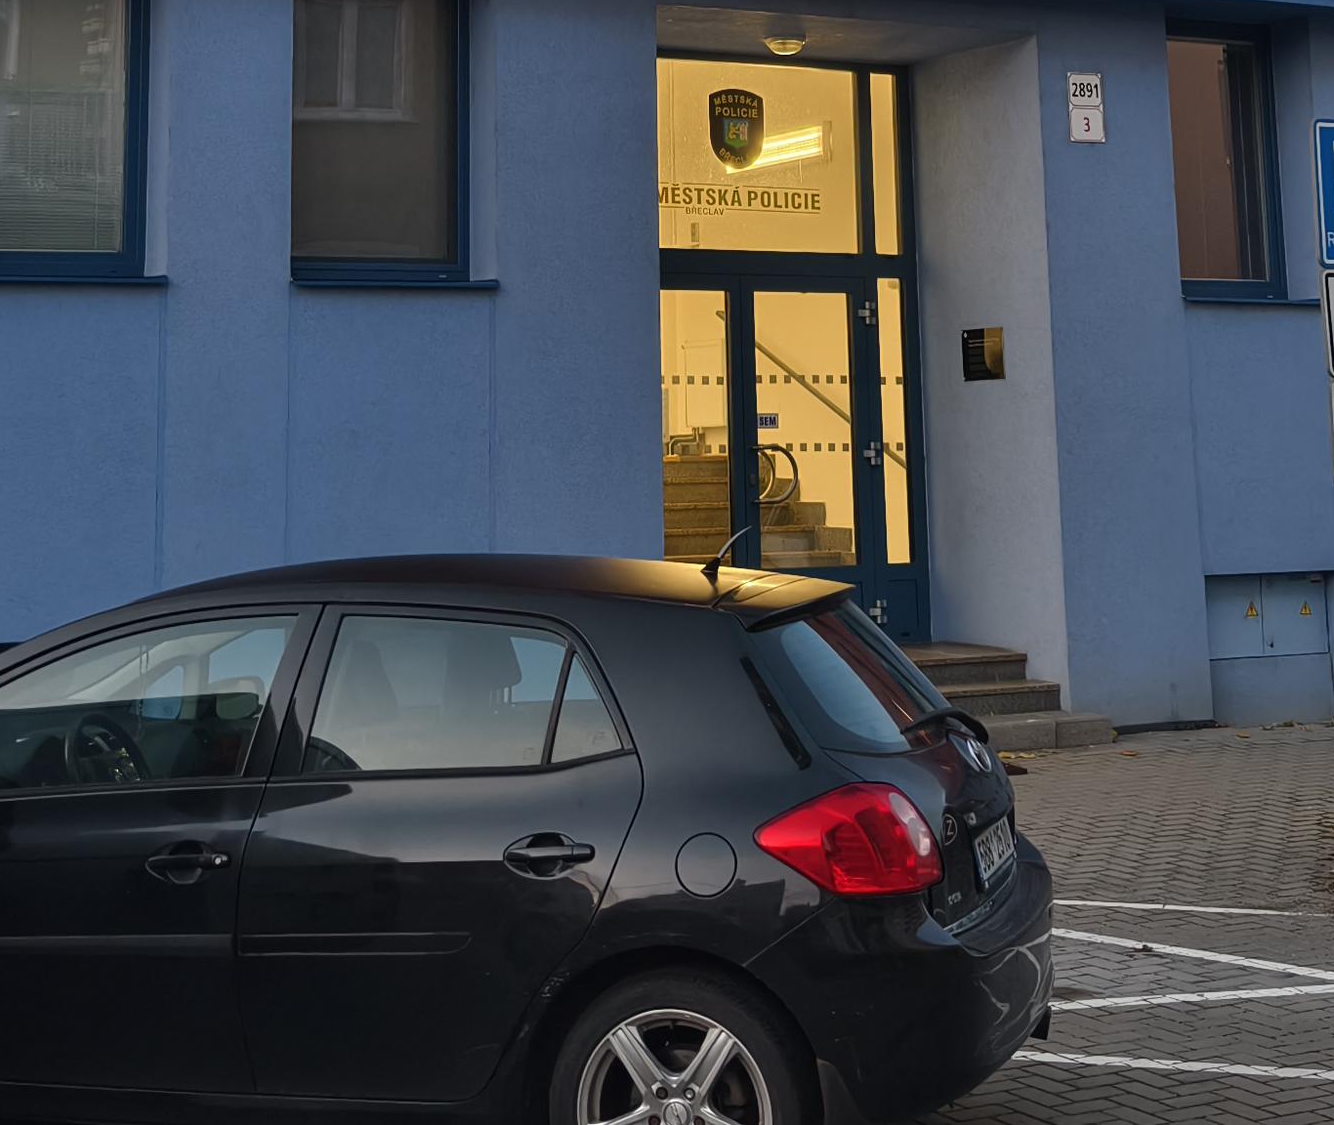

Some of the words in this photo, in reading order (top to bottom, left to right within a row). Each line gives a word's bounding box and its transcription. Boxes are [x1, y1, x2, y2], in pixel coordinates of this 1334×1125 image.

[1071, 82, 1099, 98] 2891
[715, 107, 759, 118] POLICIE
[1083, 117, 1091, 132] 3
[658, 184, 742, 206] MĚSTSKÁ
[747, 190, 821, 210] POLICIE
